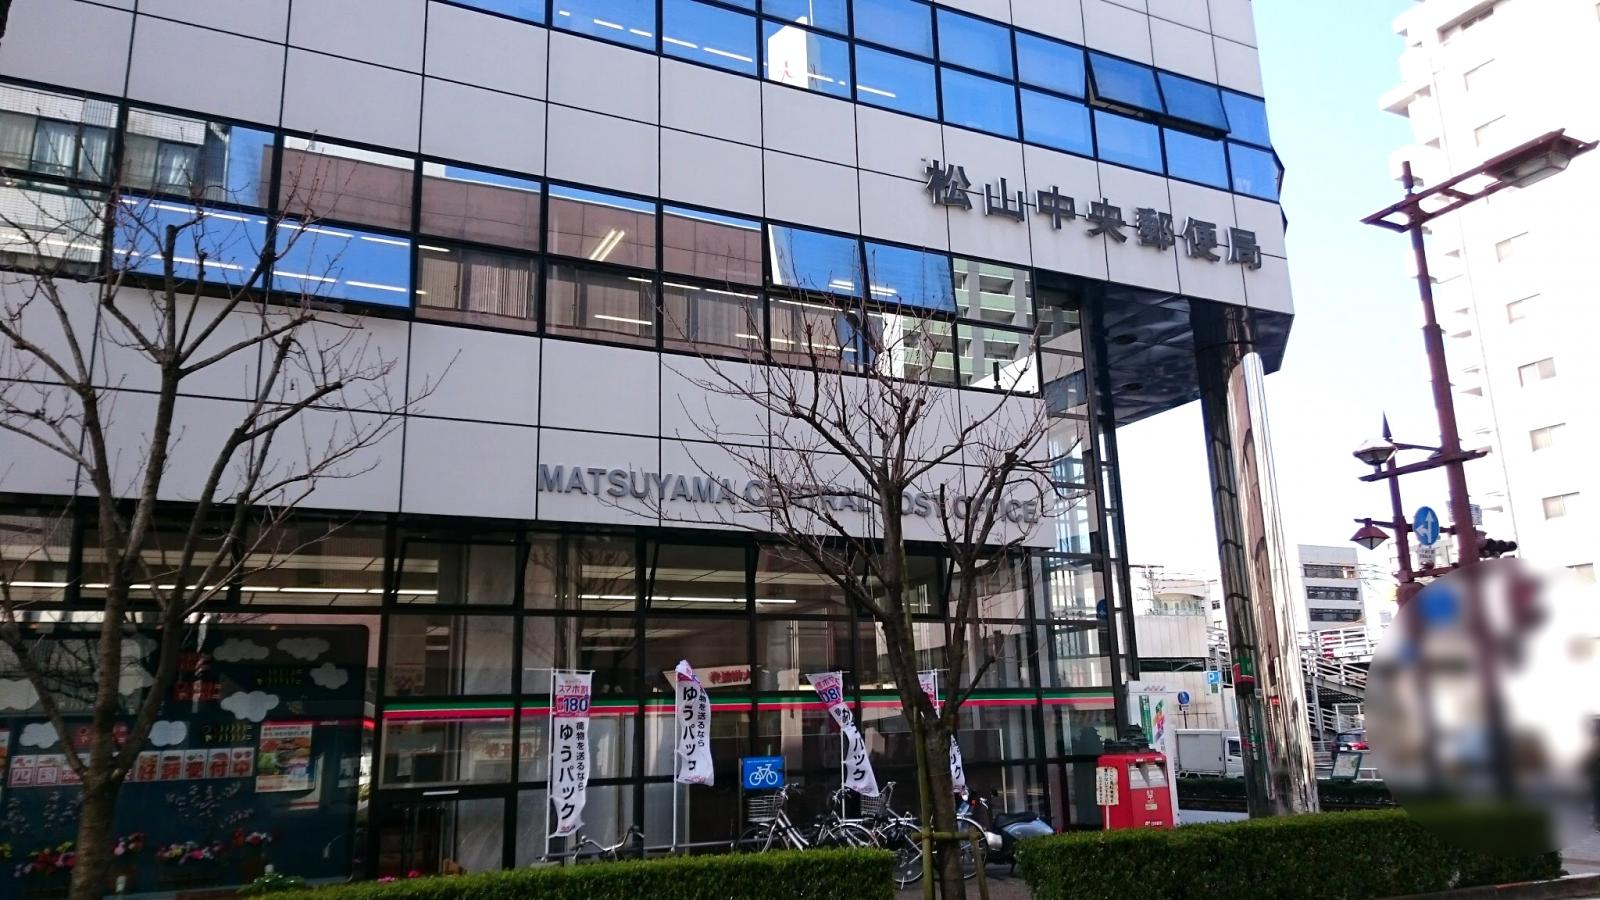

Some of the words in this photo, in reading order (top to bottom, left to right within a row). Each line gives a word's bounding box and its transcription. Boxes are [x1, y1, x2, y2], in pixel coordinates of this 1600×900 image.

[924, 159, 1262, 270] 松山中央郵便局
[538, 463, 736, 504] MATSUYAMA
[559, 724, 575, 820] ゆうパック
[575, 721, 585, 792] 荷物を送るなら
